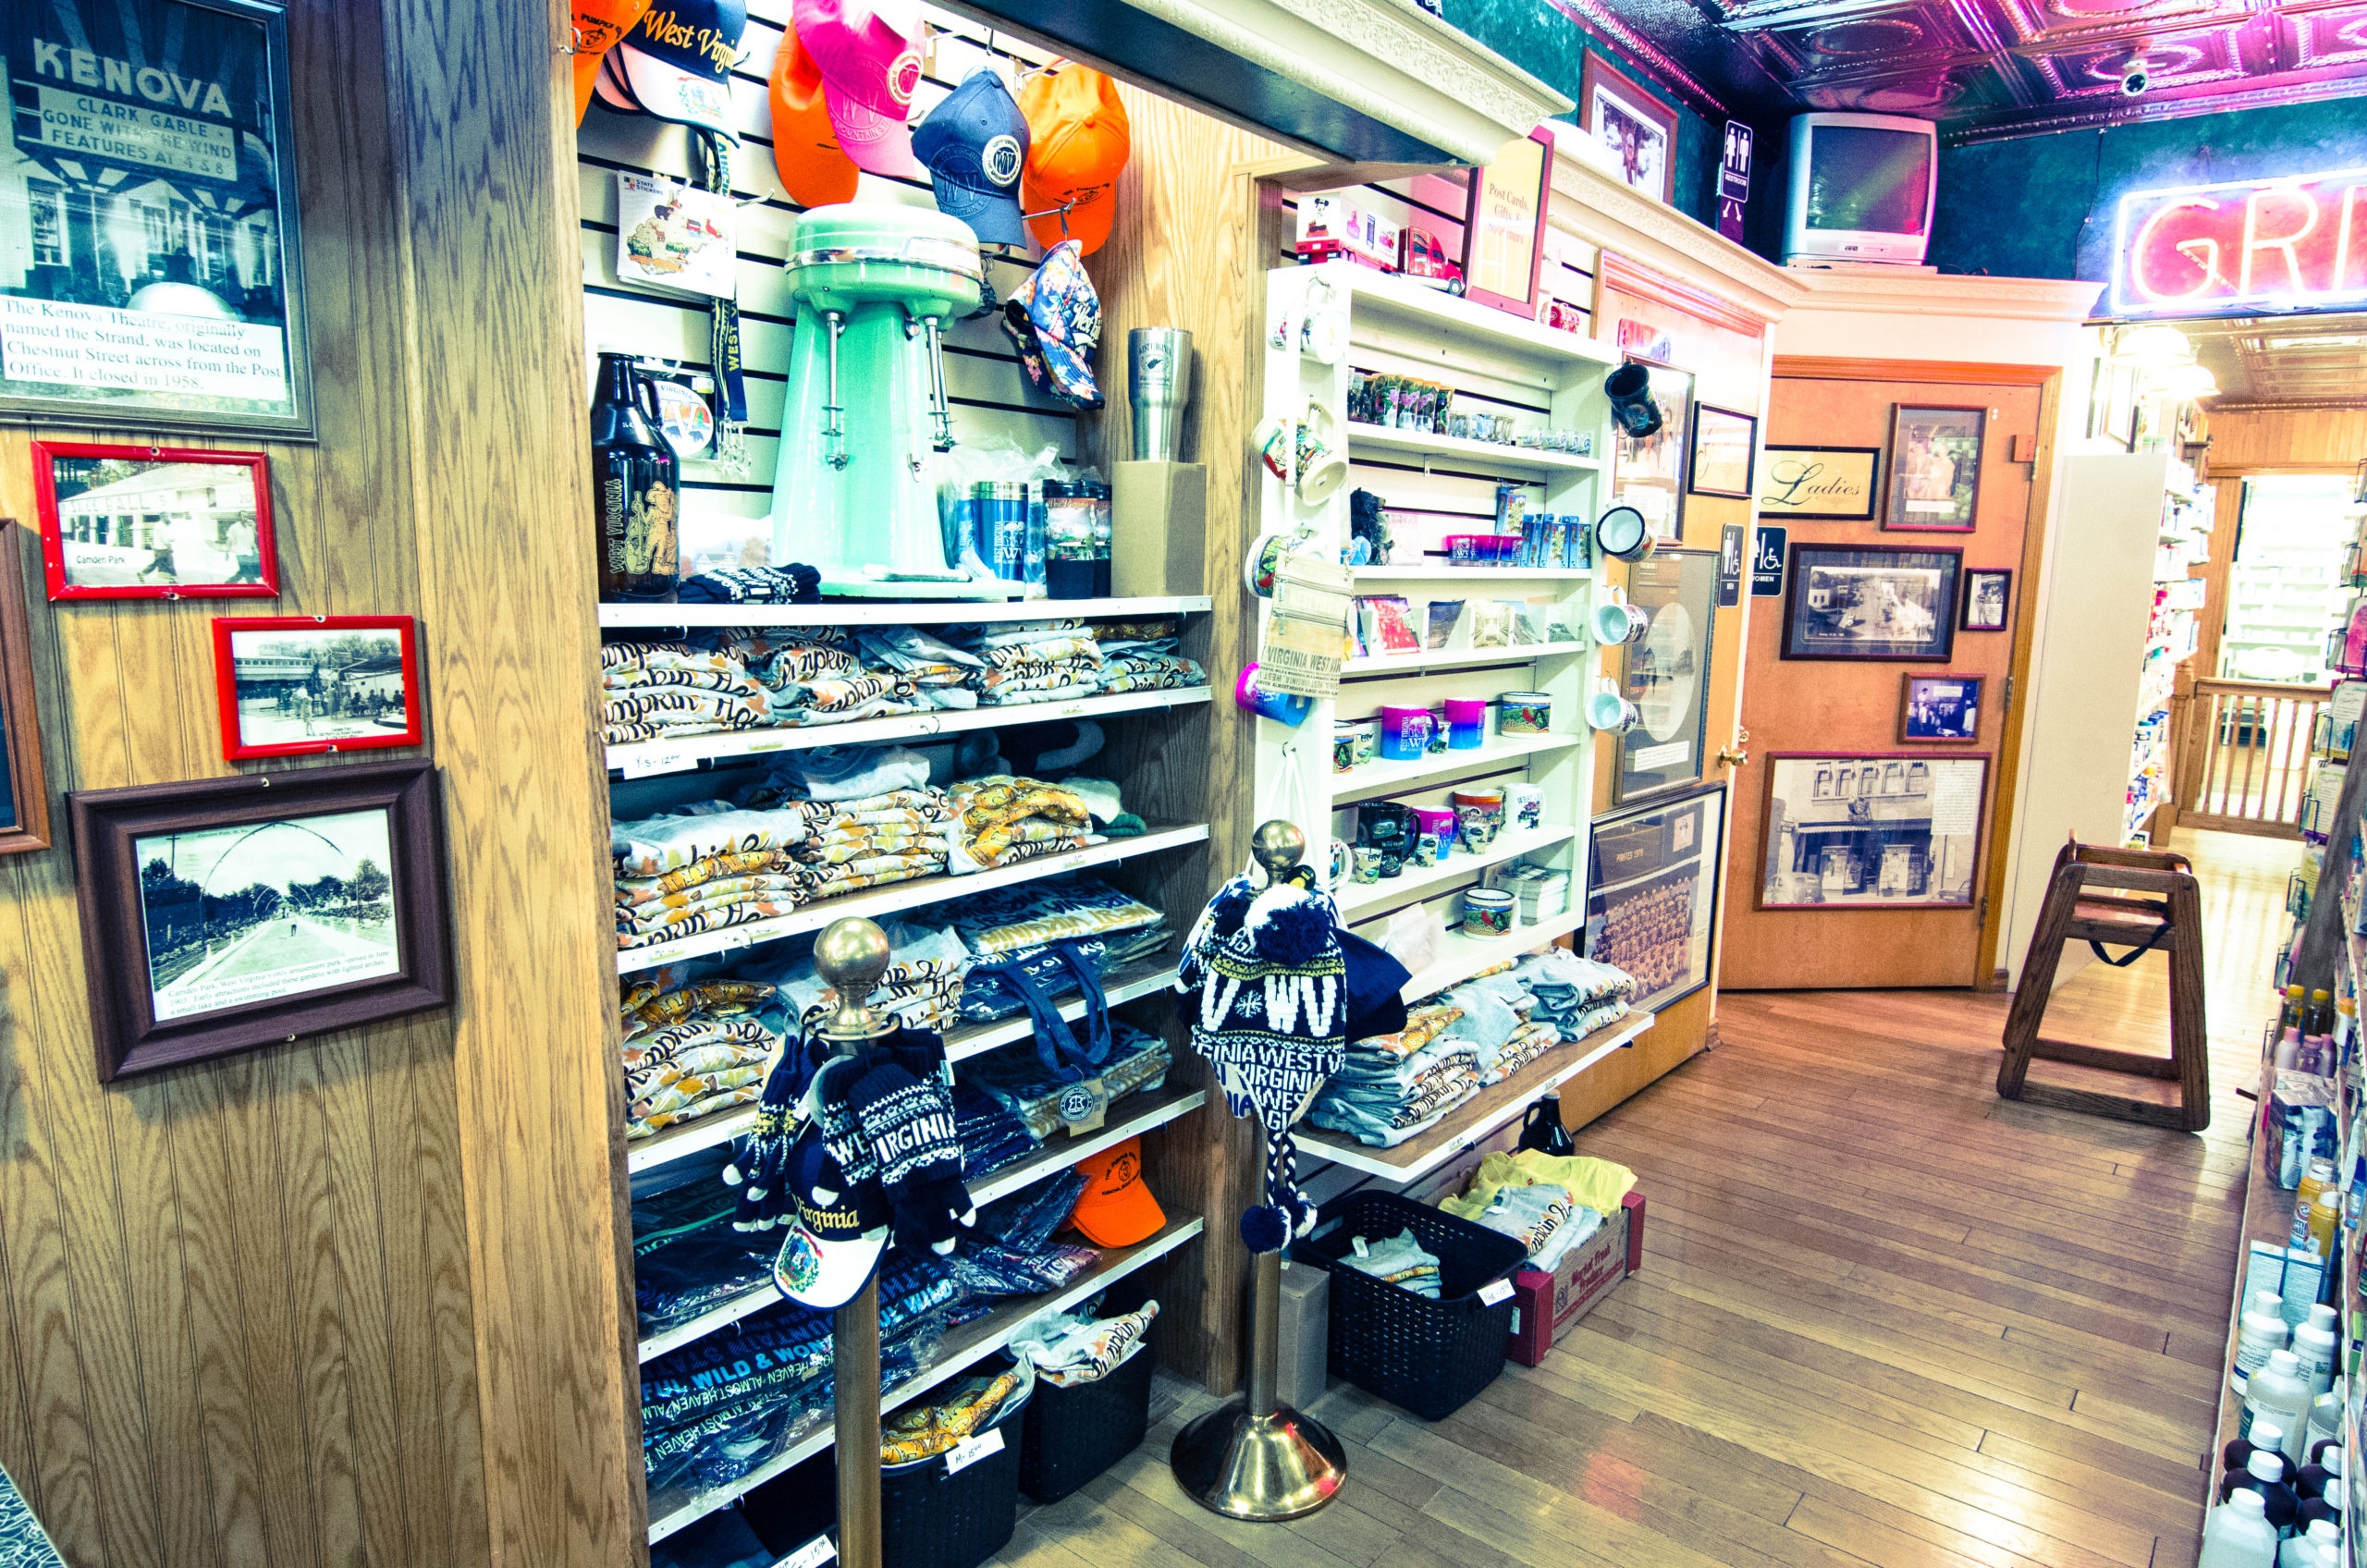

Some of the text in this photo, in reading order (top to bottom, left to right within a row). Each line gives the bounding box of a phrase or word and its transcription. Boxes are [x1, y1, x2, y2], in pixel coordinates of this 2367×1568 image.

[644, 9, 695, 49] West
[33, 37, 233, 118] KENOVA
[43, 109, 98, 131] GONE
[188, 140, 232, 160] WIND
[77, 97, 208, 138] CLARK GABLE
[53, 129, 149, 161] FEATURES
[154, 151, 174, 165] AT
[635, 178, 655, 189] STATE
[635, 185, 664, 196] STICKERS
[1725, 173, 1747, 187] RESTROOM
[1489, 183, 1529, 214] Post Cards,
[5, 299, 245, 342] The Kenova Theatre, originally
[6, 323, 60, 338] named
[66, 326, 90, 341] the
[154, 338, 183, 350] was
[188, 338, 240, 357] located
[243, 347, 262, 358] on
[728, 325, 740, 372] WEST
[7, 340, 282, 378] Chestnut Street across from the Post
[73, 366, 84, 380] It
[89, 368, 139, 386] closed
[143, 373, 158, 386] in
[164, 375, 204, 391] 1958.
[1761, 459, 1860, 506] Ladies
[604, 478, 626, 576] VIRGINIA WEST
[77, 555, 126, 564] Camden Park
[1268, 645, 1307, 668] VIRGINIA
[1310, 654, 1331, 672] WEST
[168, 986, 199, 998] Camden
[221, 978, 238, 988] West
[273, 969, 288, 980] only
[289, 962, 326, 975] amusement
[375, 949, 389, 959] June
[193, 991, 213, 1003] Early
[215, 985, 251, 998] attractions
[251, 979, 280, 992] included
[281, 974, 299, 985] these
[300, 970, 325, 983] gardens
[326, 966, 341, 975] with
[177, 1003, 197, 1014] small
[198, 999, 213, 1010] lake
[215, 996, 227, 1007] and
[234, 989, 270, 1002] swimming
[1258, 1046, 1325, 1072] WEST
[792, 1192, 861, 1233] Virginia
[691, 1353, 774, 1390] WILD &
[717, 1375, 763, 1402] ALMOST
[767, 1359, 810, 1385] HEAVEN
[654, 1426, 702, 1461] HEAVEN
